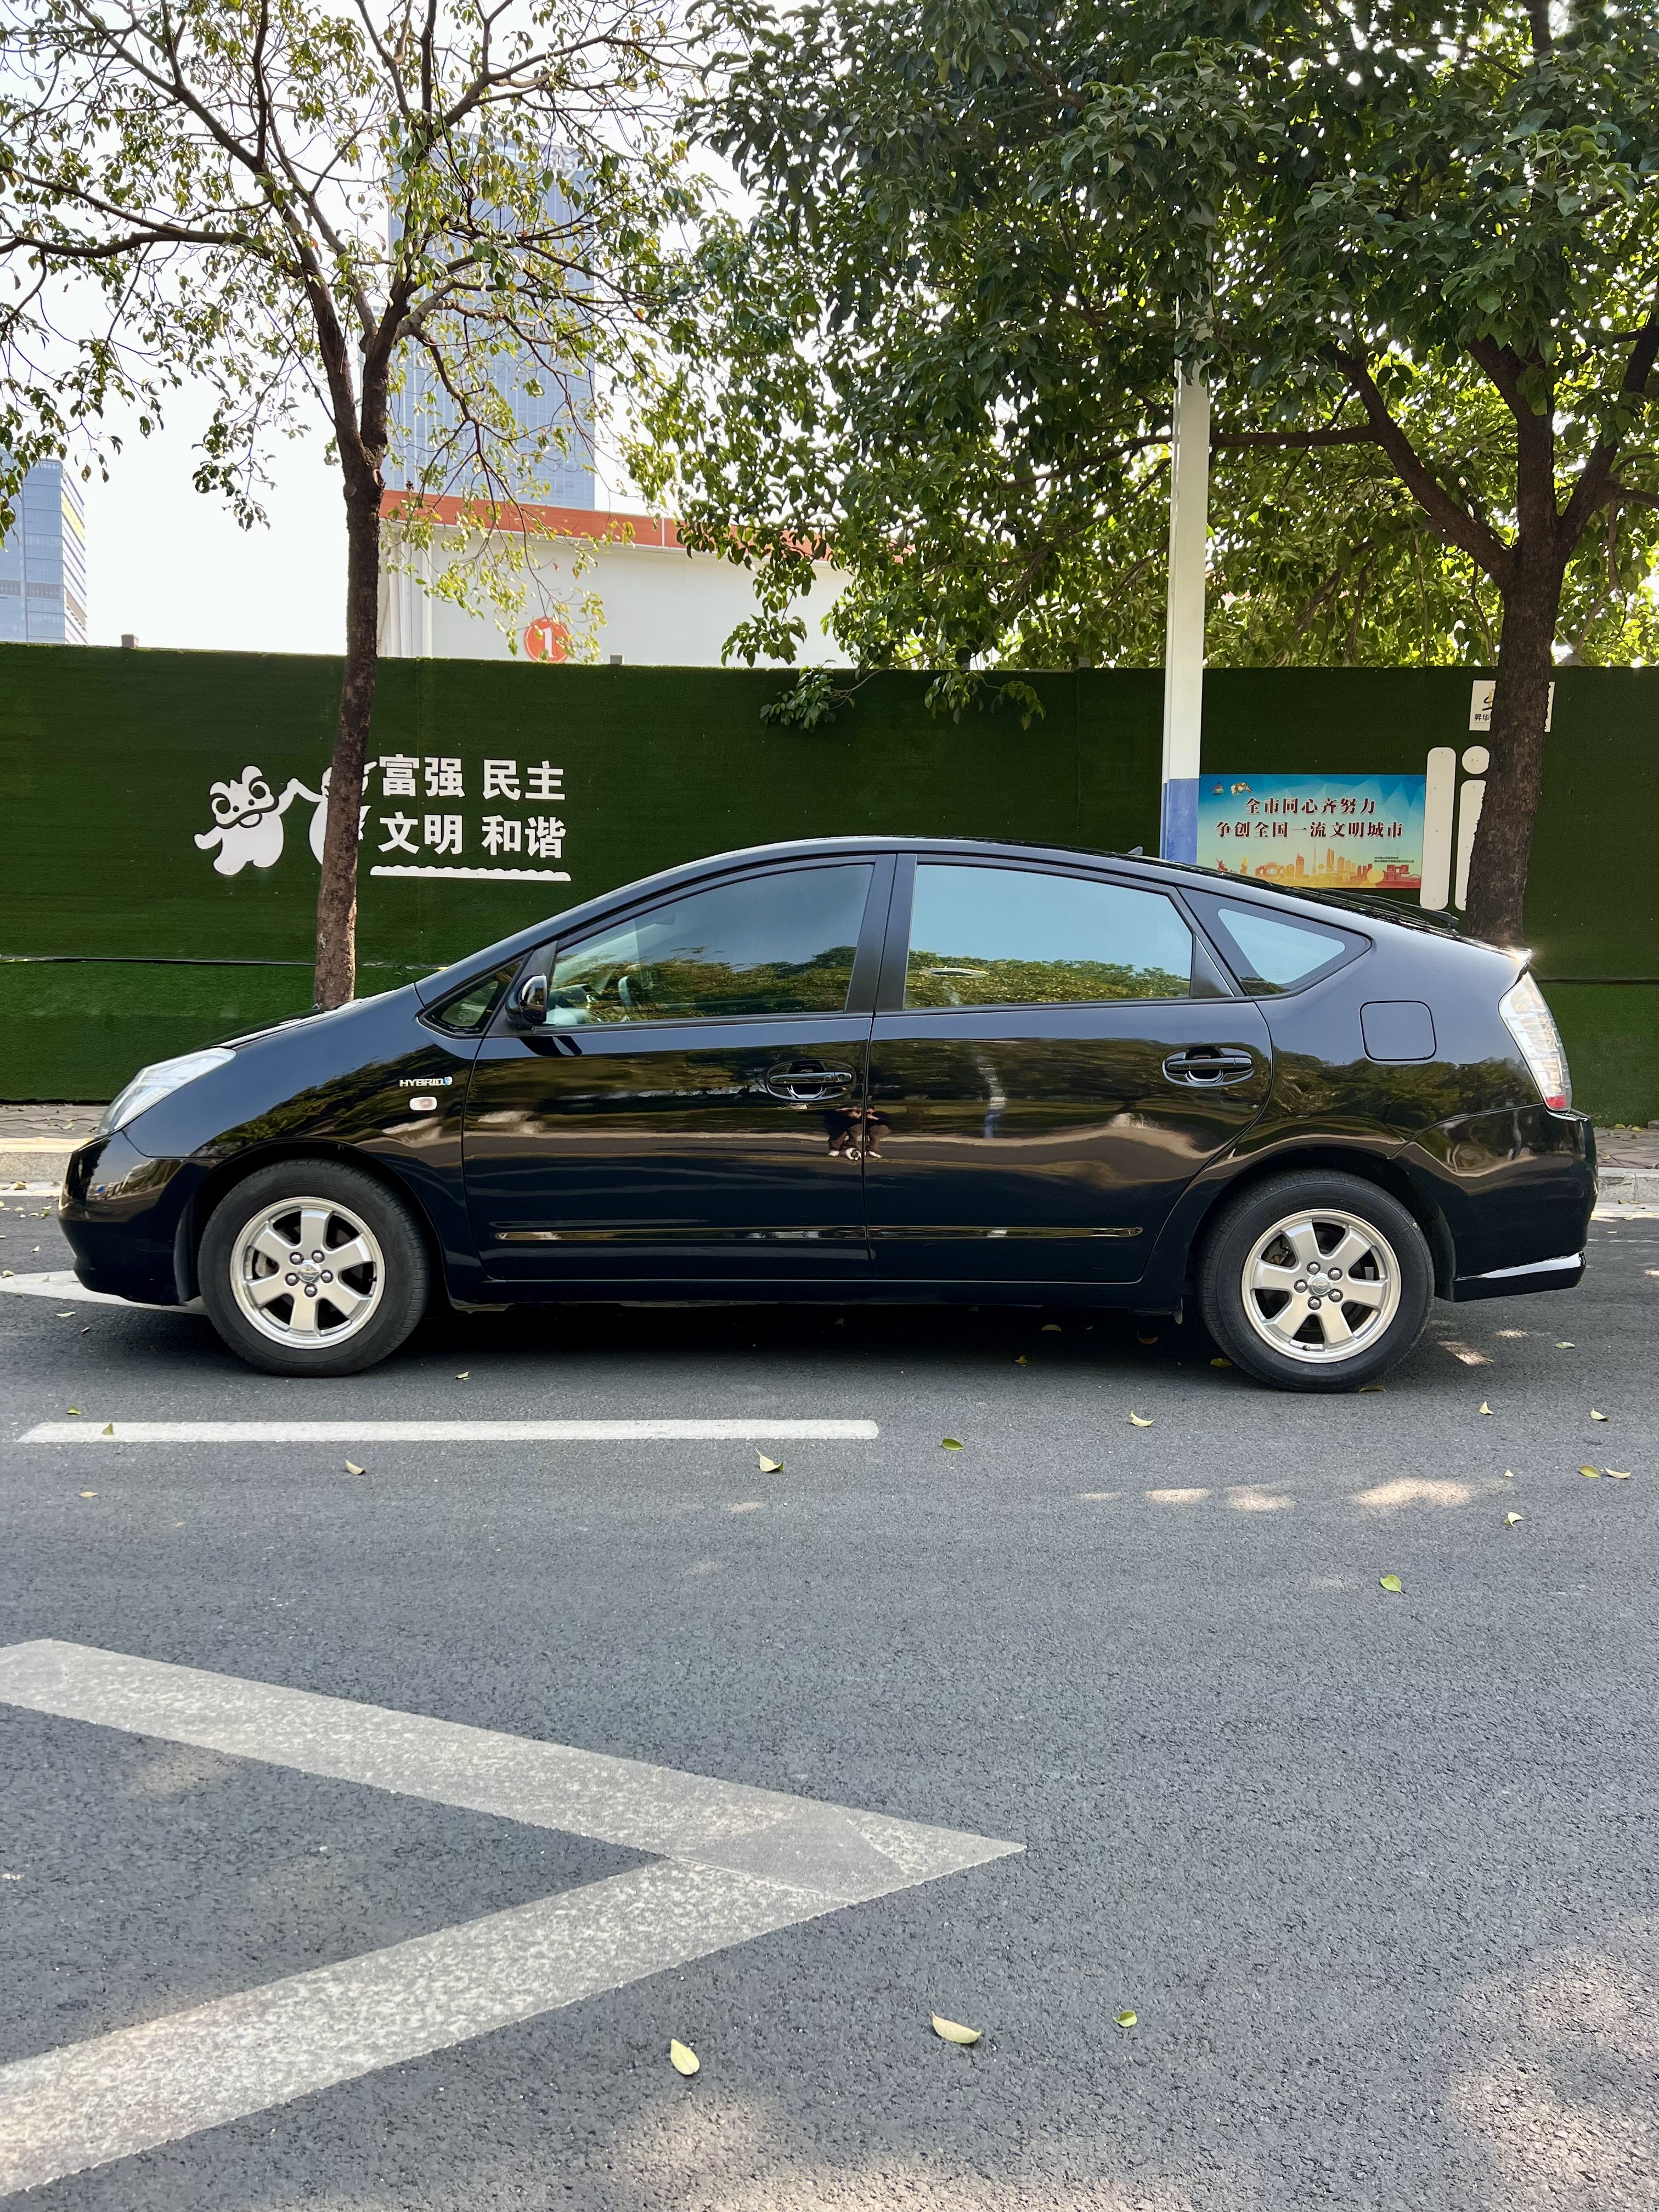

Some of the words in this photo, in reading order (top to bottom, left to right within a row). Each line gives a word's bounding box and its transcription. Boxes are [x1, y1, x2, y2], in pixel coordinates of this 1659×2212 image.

[379, 753, 465, 798] 富强
[482, 759, 565, 800] 民主
[1245, 798, 1375, 815] 全市同心齐努力
[378, 811, 462, 855] 文明
[481, 815, 566, 858] 和谐
[1215, 821, 1403, 838] 争创全国一流文明城市
[399, 1078, 445, 1087] HYBRID
